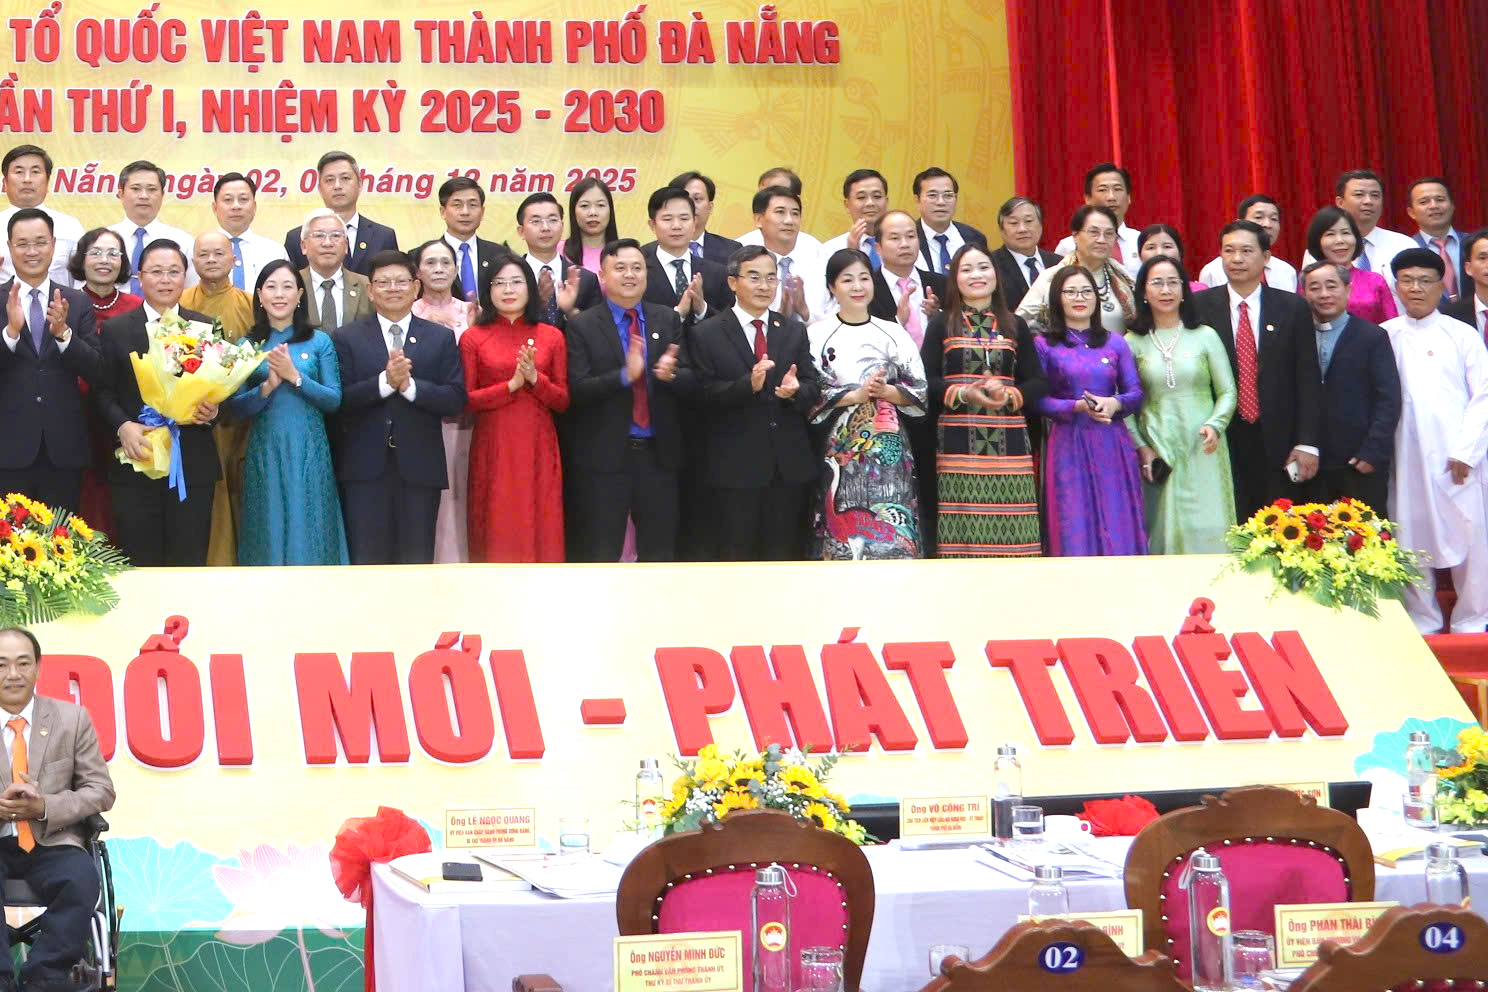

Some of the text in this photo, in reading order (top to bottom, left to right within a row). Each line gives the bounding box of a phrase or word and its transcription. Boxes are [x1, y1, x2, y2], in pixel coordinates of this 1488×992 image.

[9, 0, 63, 63] TỔ
[76, 3, 187, 68] QUỐC
[201, 10, 289, 72] VIỆT
[303, 19, 402, 63] NAM
[414, 11, 553, 64] THÀNH
[566, 4, 648, 64] PHỐ
[658, 12, 716, 64] ĐÀ
[727, 5, 841, 64] NẴNG
[67, 79, 153, 133] THỨ
[163, 89, 187, 139] I,
[202, 80, 338, 143] NHIỆM
[353, 79, 406, 133] KỲ
[421, 89, 522, 133] 2025
[564, 89, 665, 133] 2030
[360, 167, 434, 199] háng
[490, 167, 555, 193] năm
[294, 631, 546, 765] MỚI
[655, 627, 968, 757] PHÁT
[984, 597, 1350, 746] TRIỂN
[1310, 919, 1337, 932] PHAN
[1424, 926, 1460, 949] 04
[630, 950, 646, 964] Ông
[648, 946, 682, 962] NGUYỄN
[684, 948, 706, 961] MINH
[1045, 946, 1078, 968] 02
